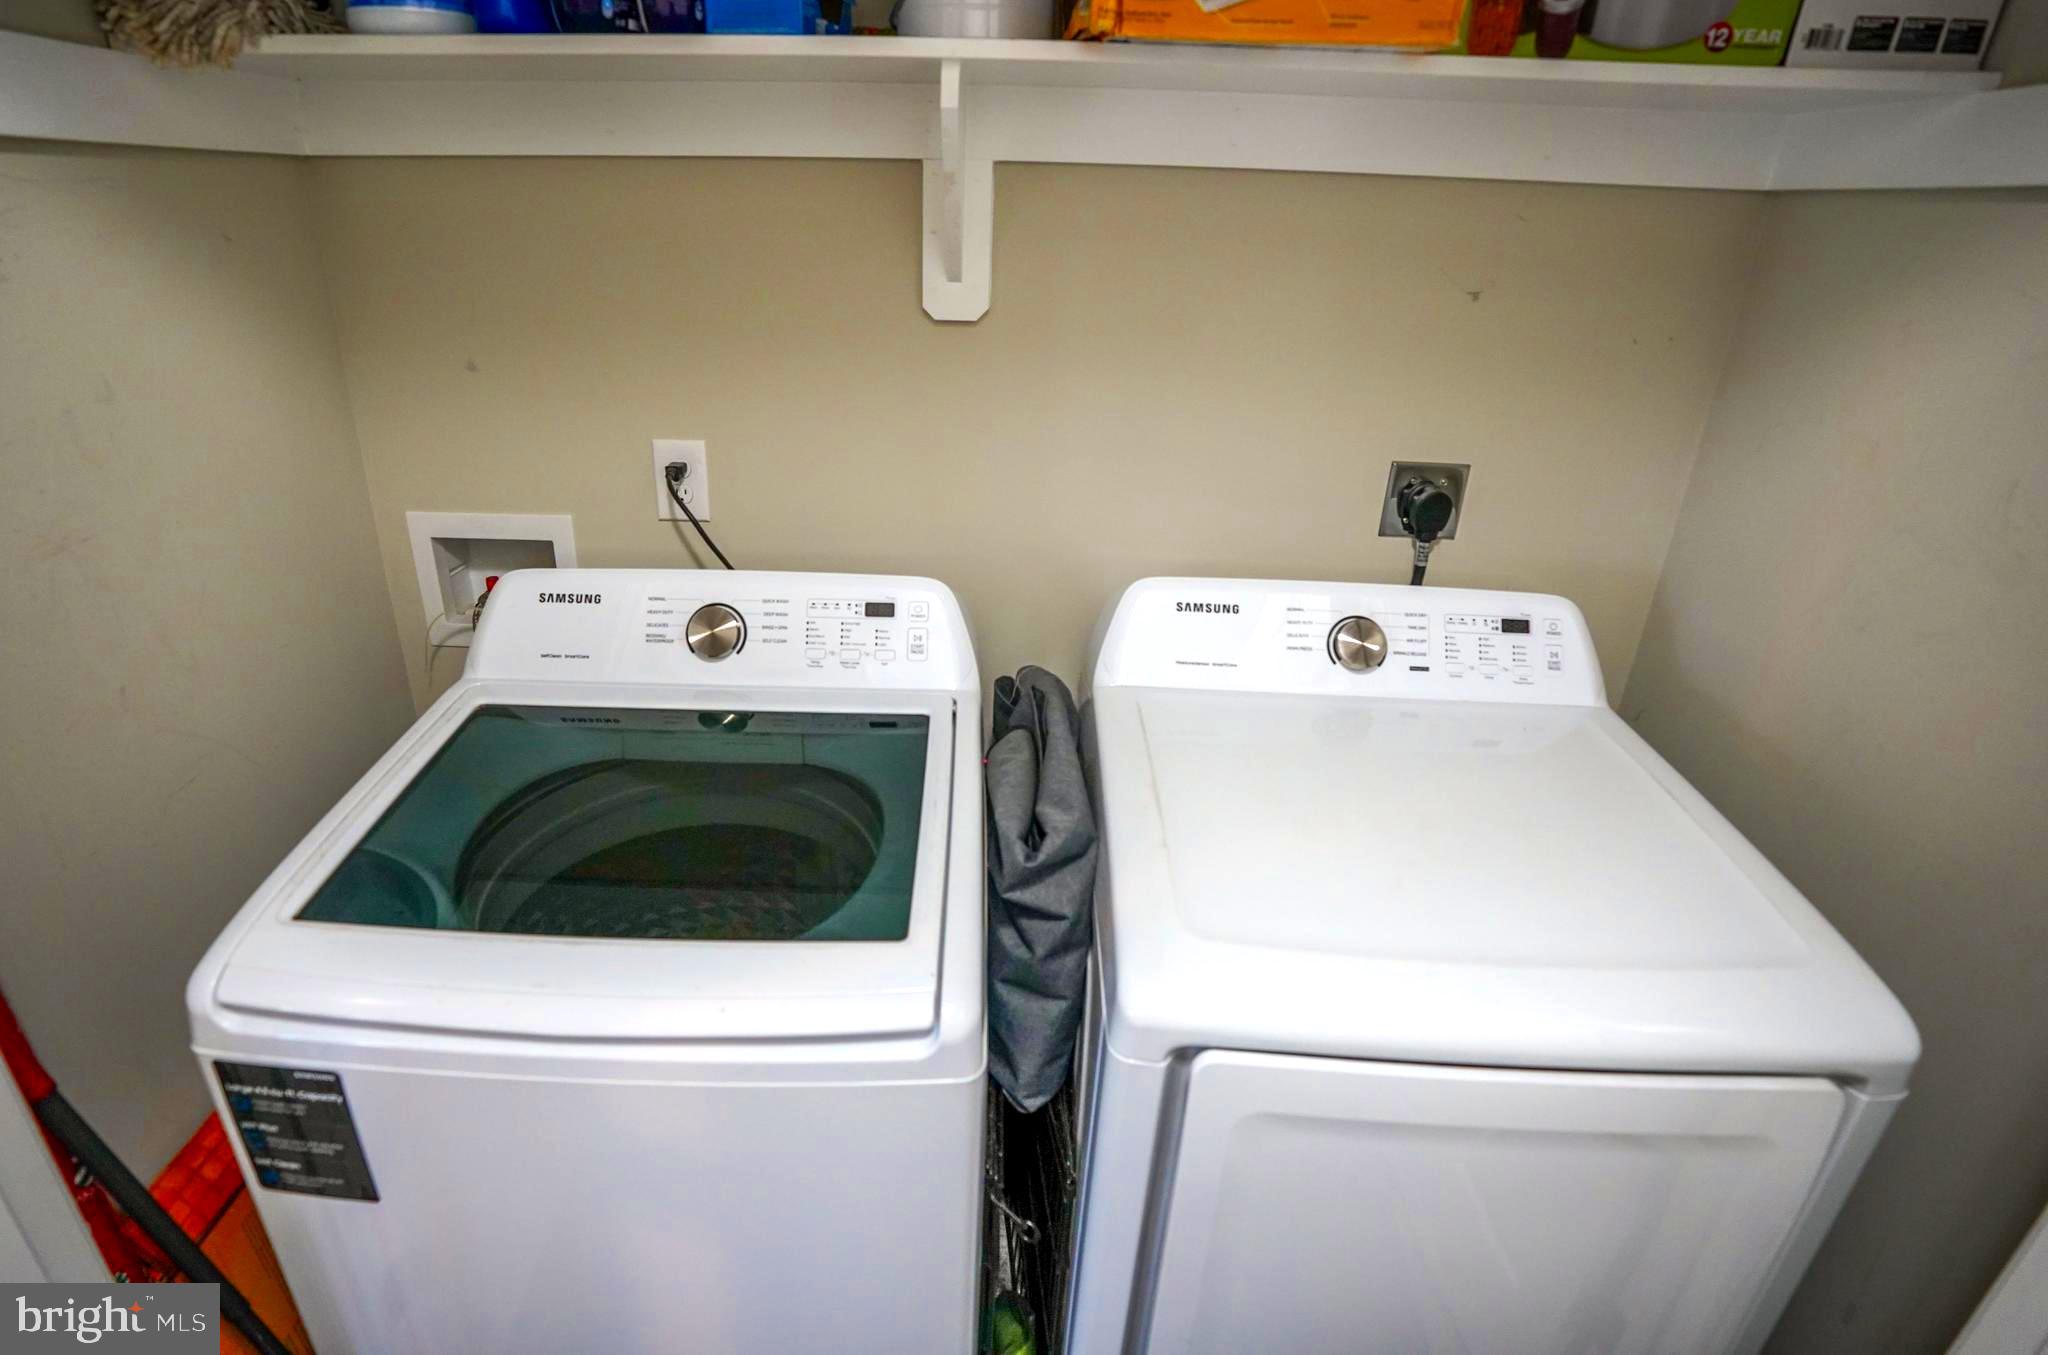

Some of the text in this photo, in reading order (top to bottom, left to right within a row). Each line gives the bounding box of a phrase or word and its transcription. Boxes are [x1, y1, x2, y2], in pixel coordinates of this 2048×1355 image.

[1708, 28, 1782, 47] 12 YEAR
[539, 592, 602, 604] SAMSUNG
[1176, 602, 1240, 614] SAMSUNG
